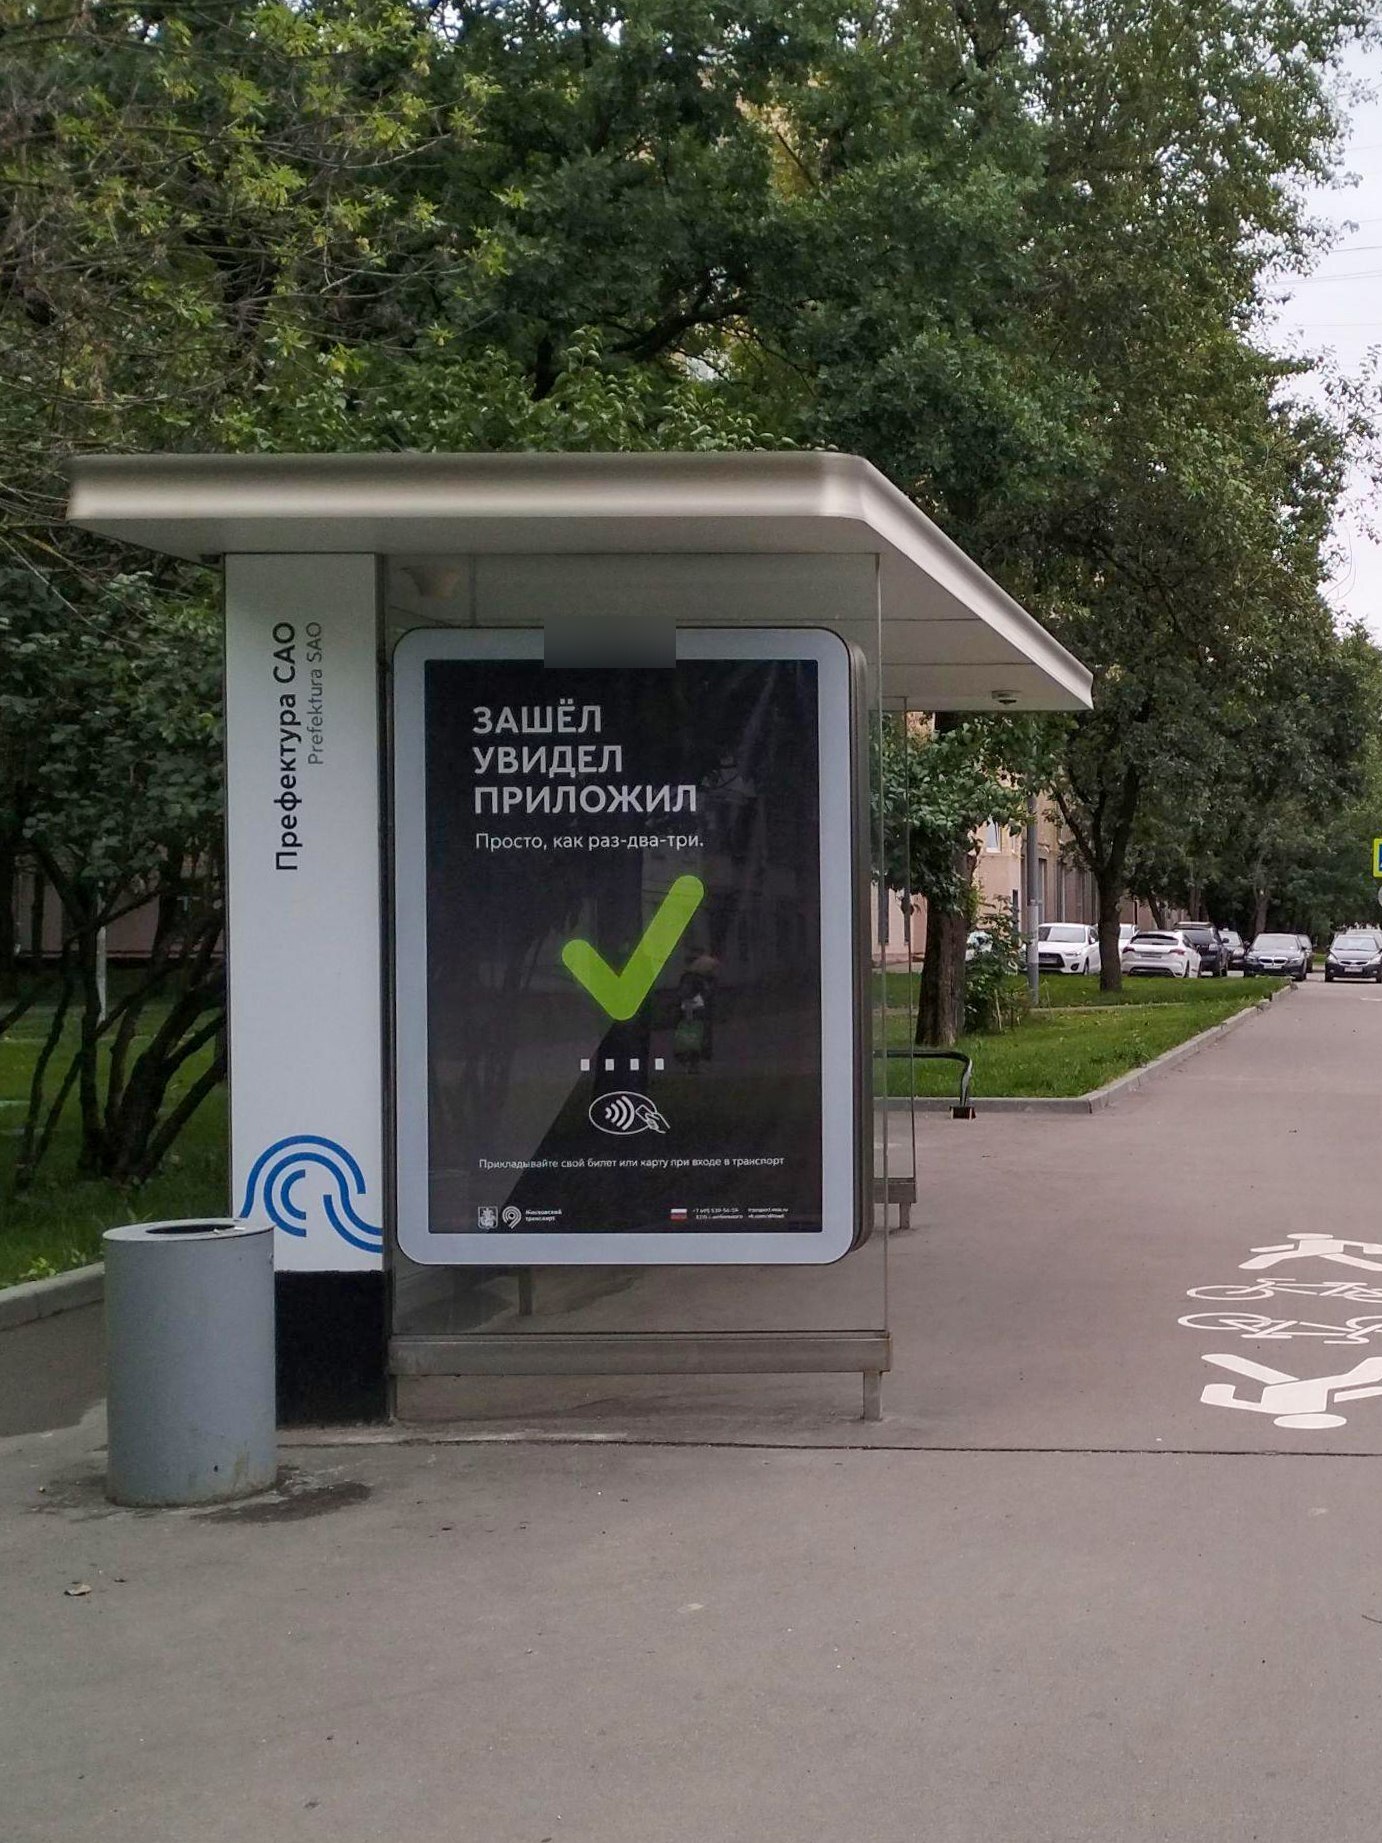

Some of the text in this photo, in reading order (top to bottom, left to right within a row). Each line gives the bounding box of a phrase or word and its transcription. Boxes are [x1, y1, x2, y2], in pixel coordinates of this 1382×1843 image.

[305, 621, 324, 765] Prefektura SAO
[472, 698, 602, 734] ЗАШЁЛ
[272, 621, 303, 871] Префектура САО
[473, 745, 623, 778] УВИДЕЛ
[474, 784, 697, 814] ПРИЛОЖИЛ
[475, 833, 704, 851] Просто, как раз-два-три.
[479, 1158, 559, 1170] Прикладывайте
[561, 1158, 585, 1168] свой
[588, 1158, 617, 1168] билет
[619, 1159, 638, 1168] или
[640, 1159, 669, 1169] карту
[671, 1159, 690, 1168] при
[692, 1158, 722, 1168] входе
[732, 1157, 785, 1168] транспорт
